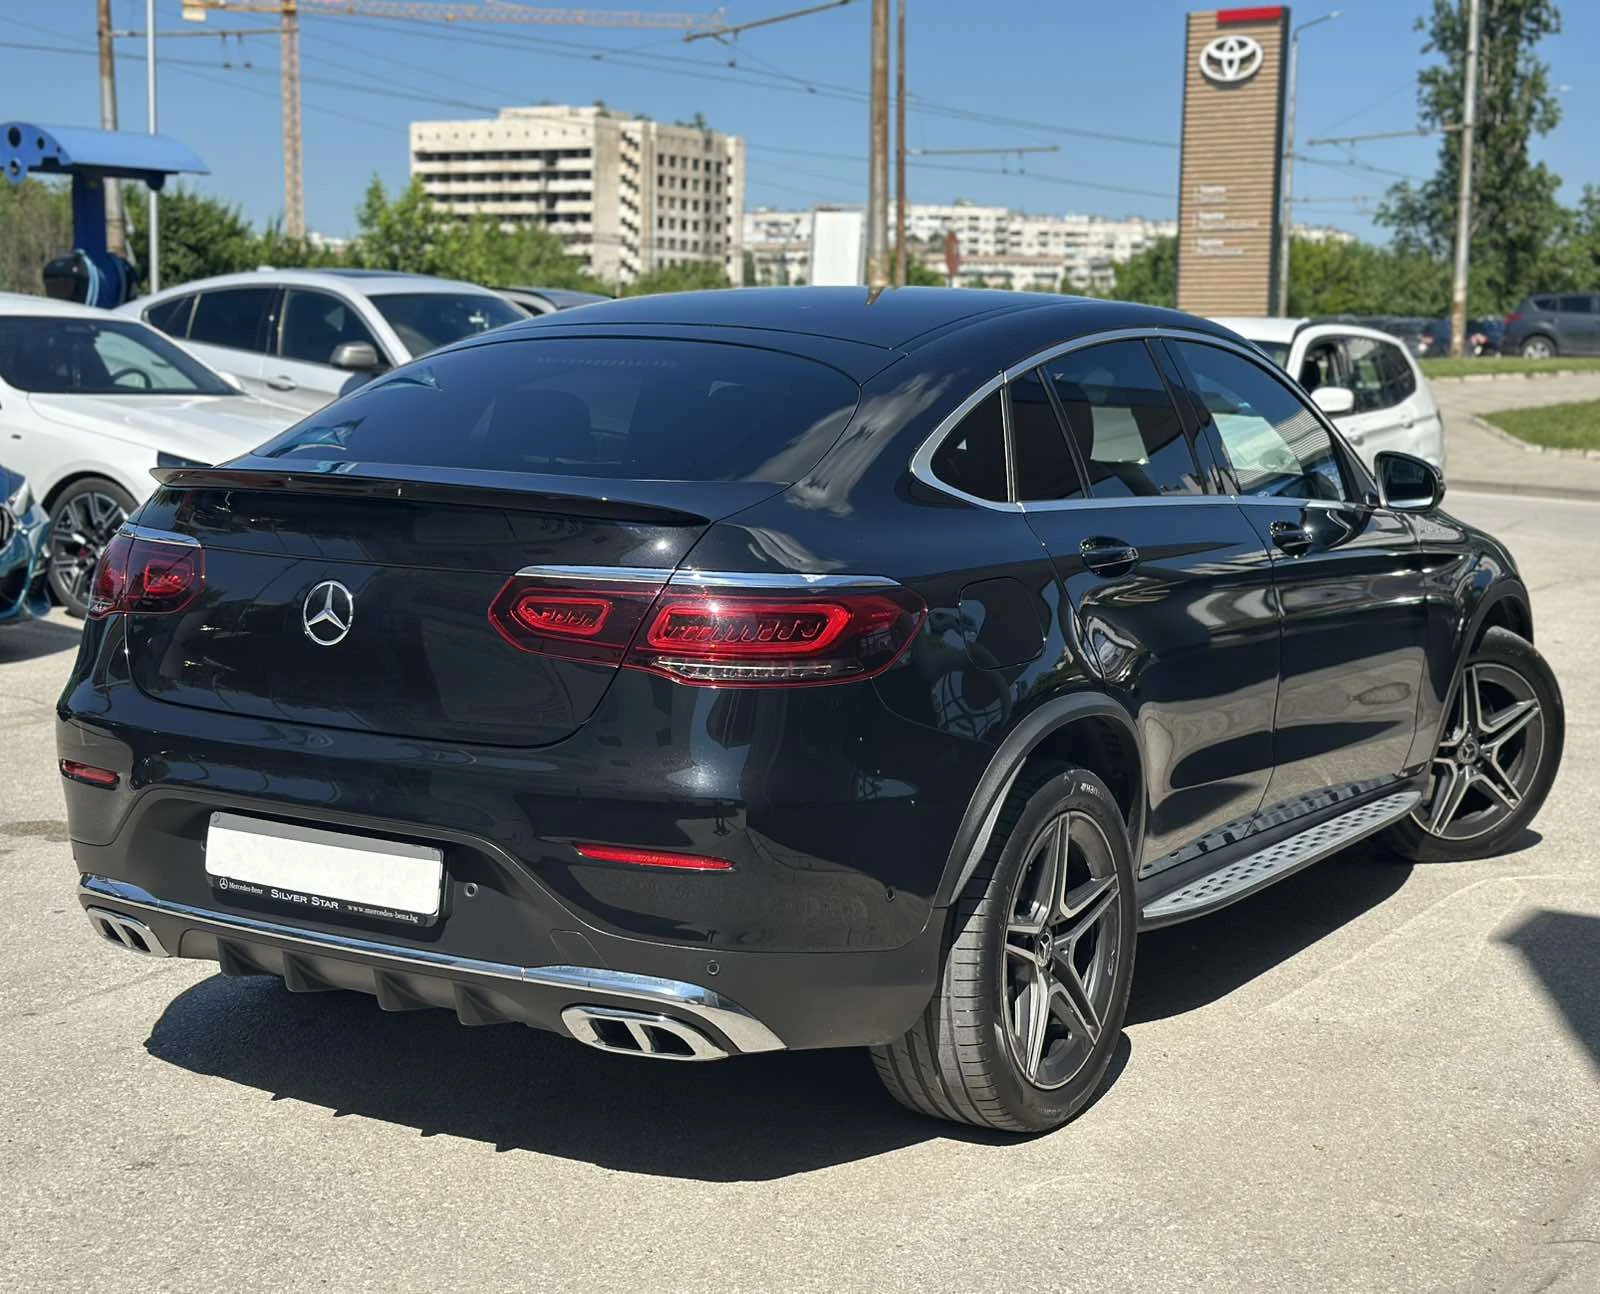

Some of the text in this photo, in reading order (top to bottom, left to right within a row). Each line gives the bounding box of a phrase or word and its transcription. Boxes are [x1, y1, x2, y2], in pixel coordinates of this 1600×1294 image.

[228, 882, 263, 894] Mercedes-Benz
[271, 889, 339, 910] SILVER STAR
